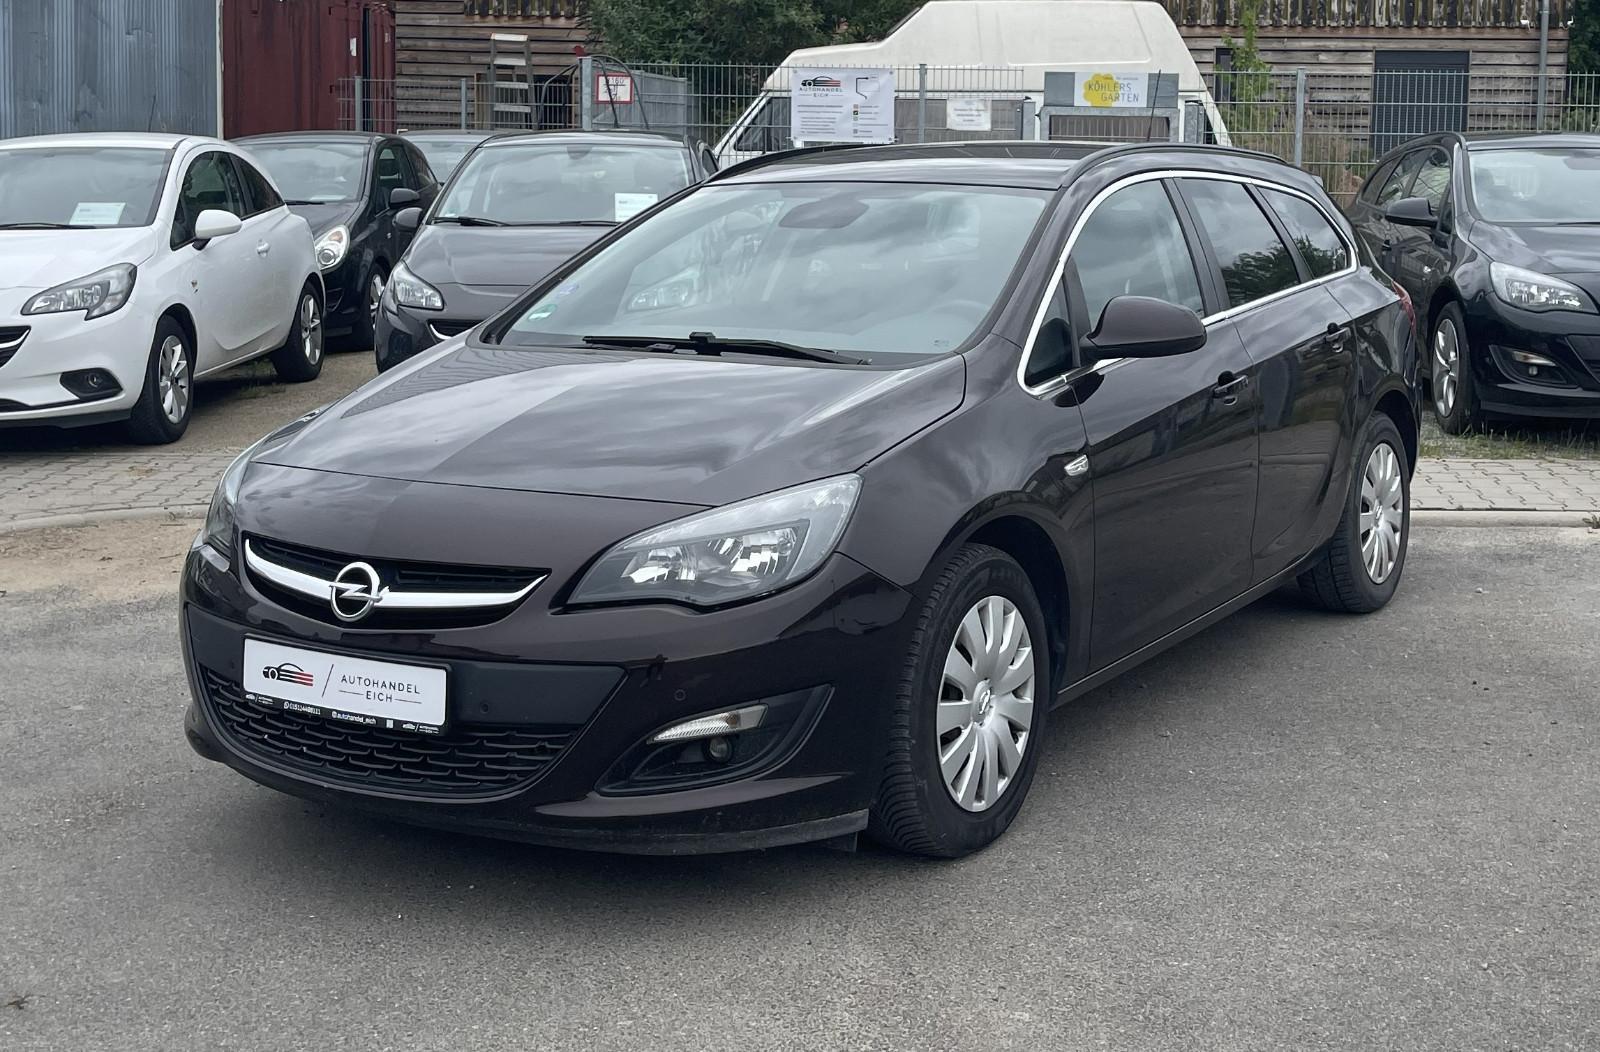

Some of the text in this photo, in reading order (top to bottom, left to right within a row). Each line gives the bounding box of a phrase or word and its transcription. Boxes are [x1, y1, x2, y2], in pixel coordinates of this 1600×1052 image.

[1088, 80, 1132, 91] KÖHLERS
[1101, 93, 1139, 102] GARTEN
[340, 674, 421, 695] AUTOHANDEL
[365, 690, 394, 703] EICH
